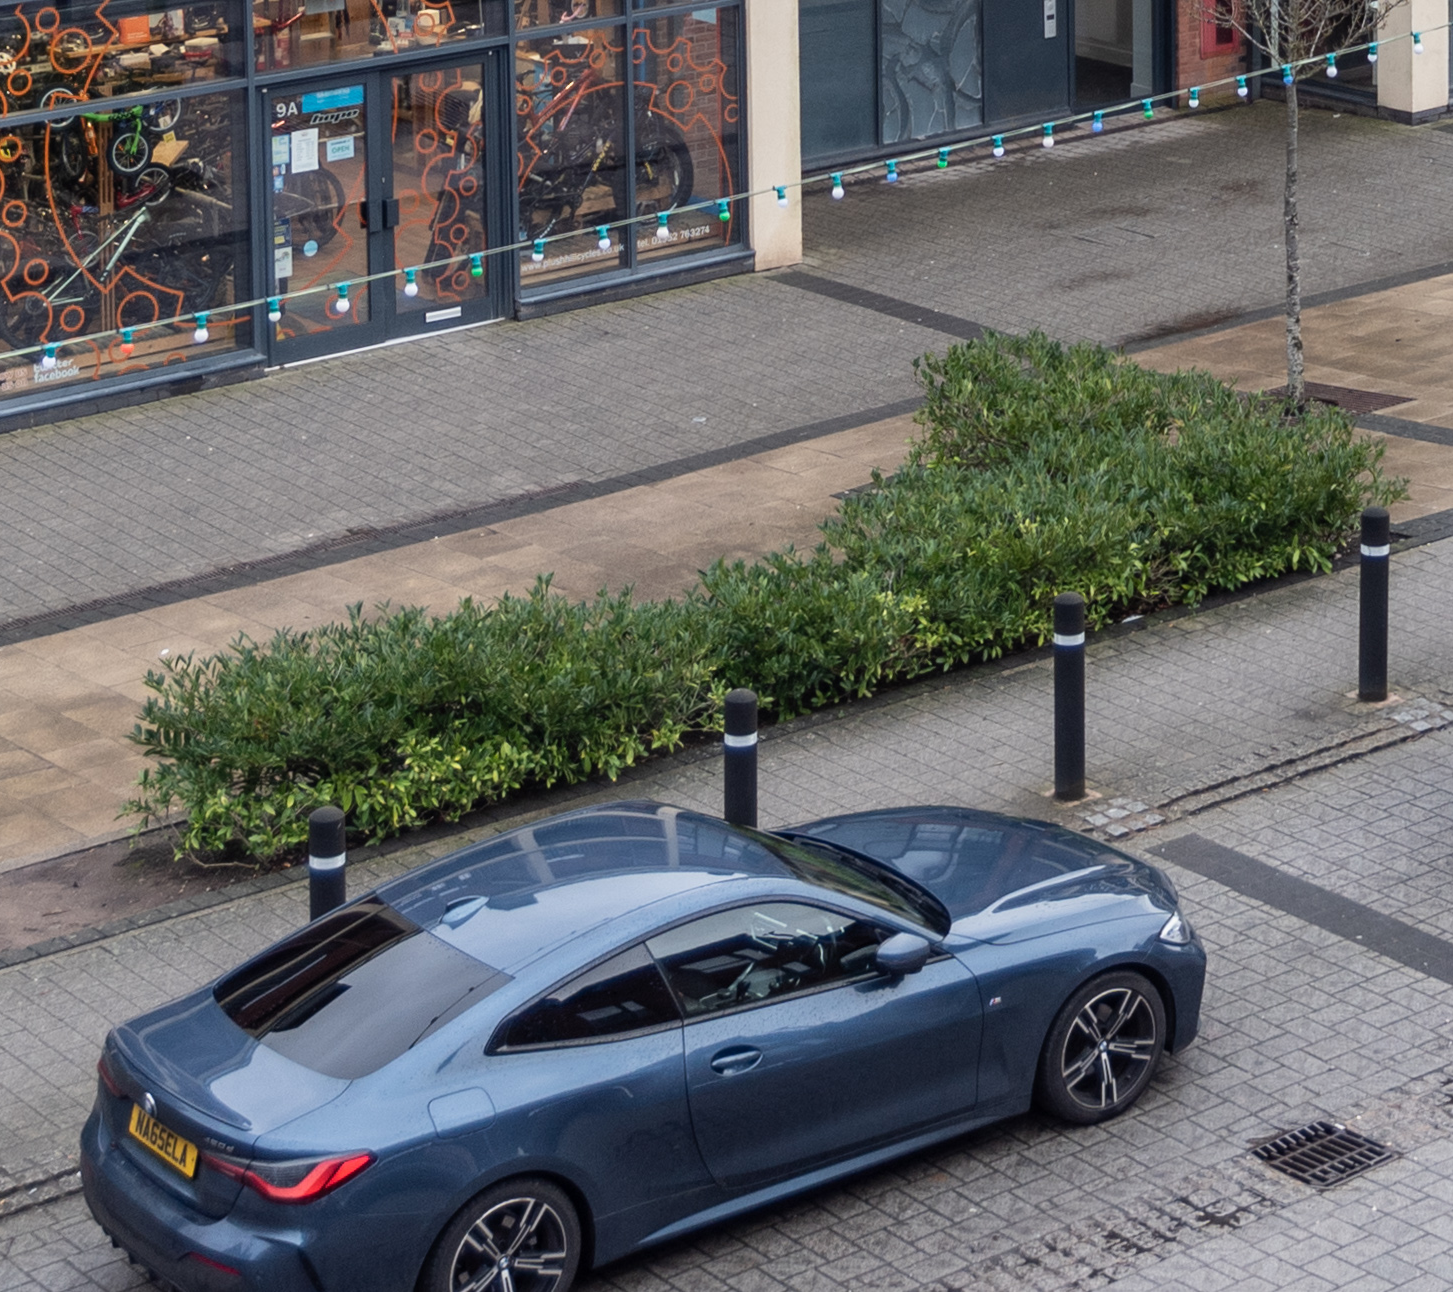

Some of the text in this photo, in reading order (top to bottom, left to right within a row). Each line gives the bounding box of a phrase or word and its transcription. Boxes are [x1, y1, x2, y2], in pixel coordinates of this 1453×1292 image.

[276, 102, 298, 118] 9A
[637, 239, 649, 248] tel.
[33, 365, 80, 383] facebook
